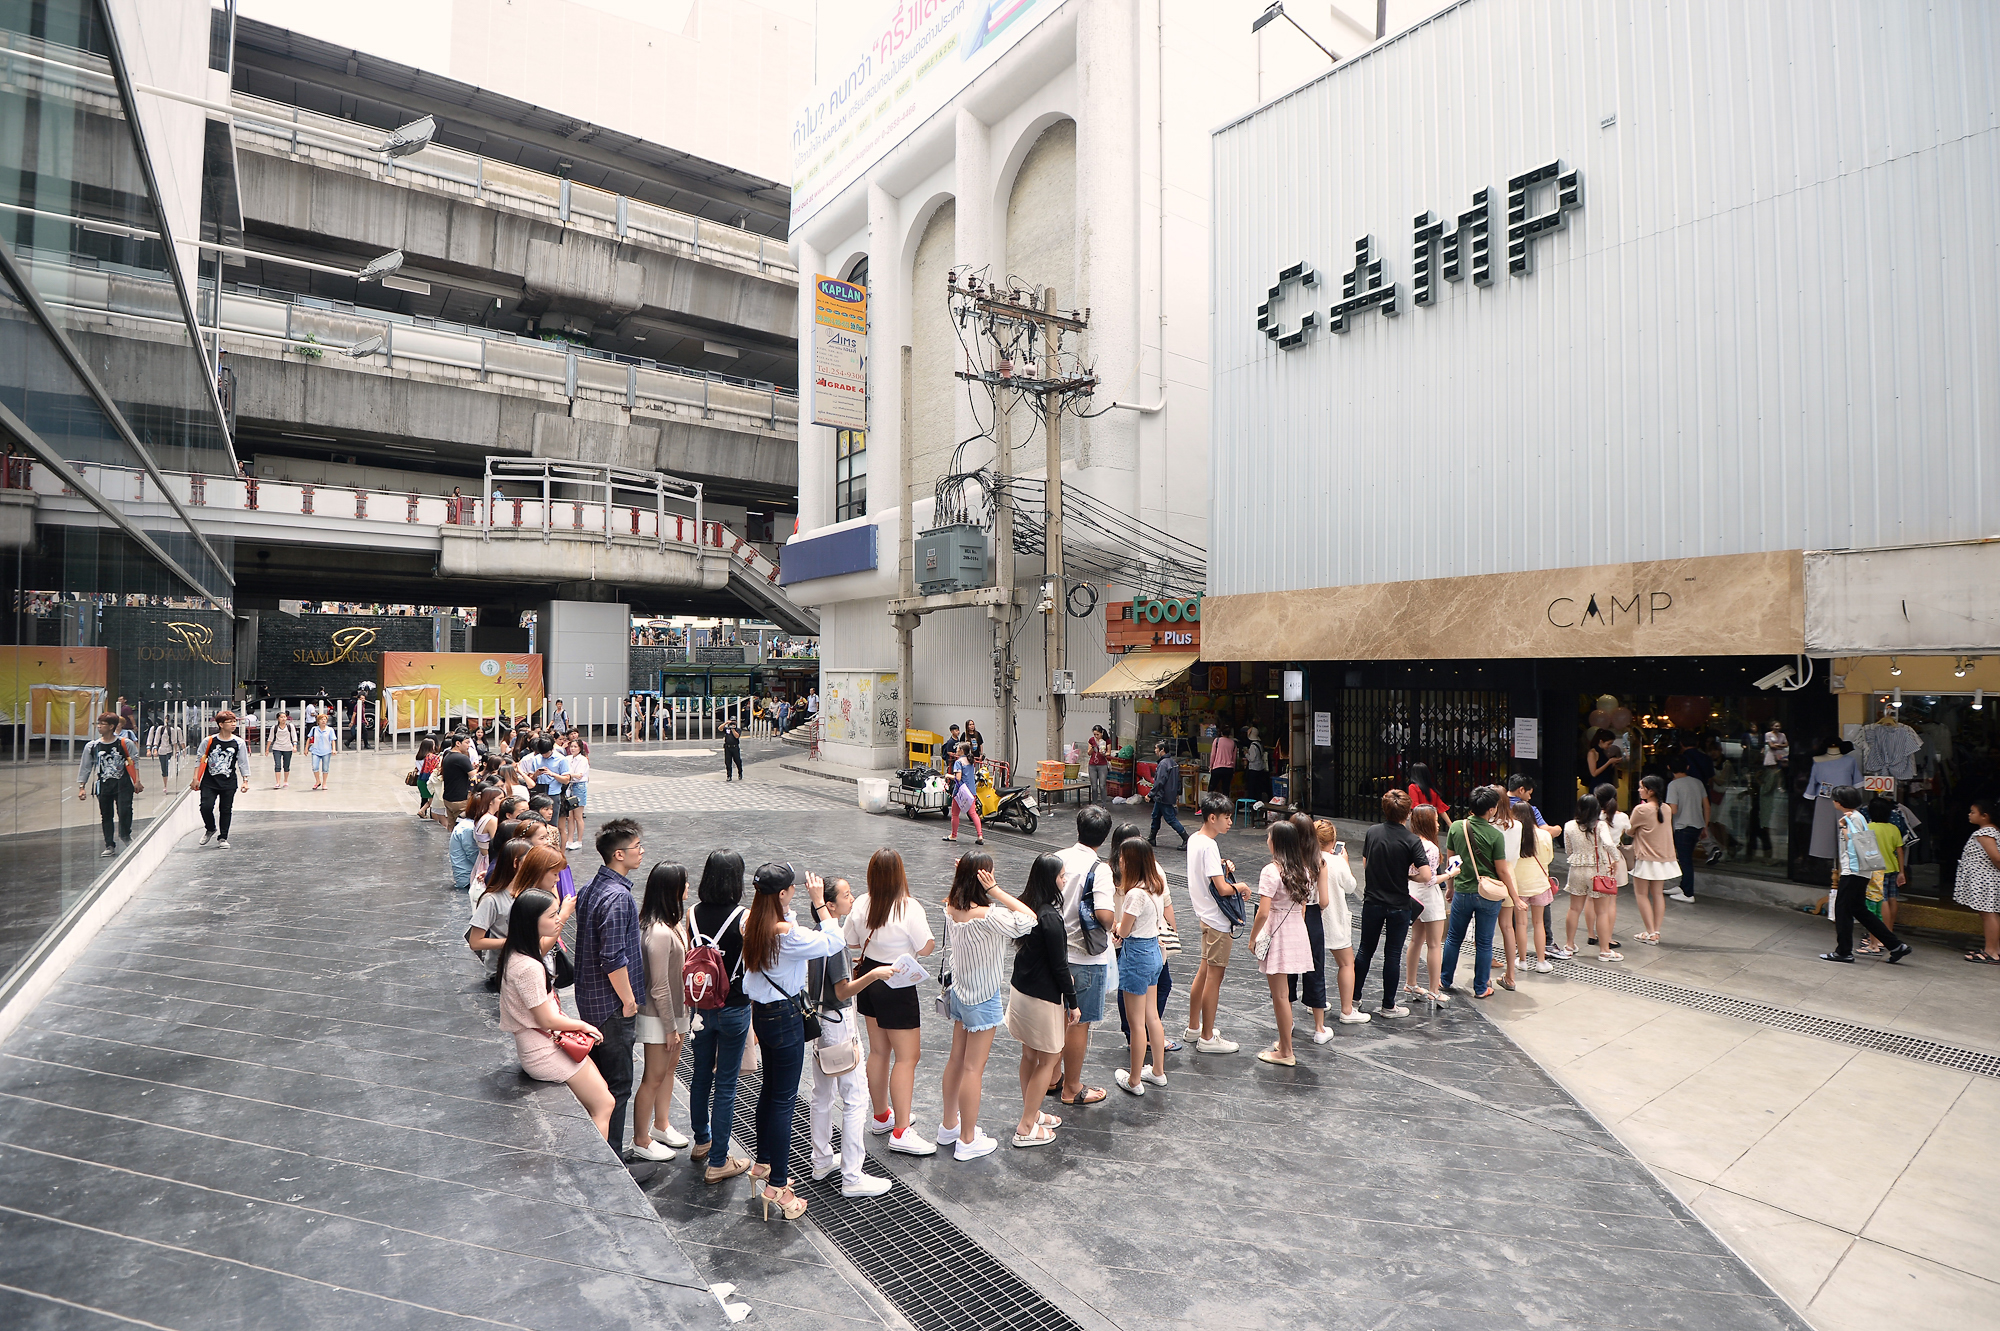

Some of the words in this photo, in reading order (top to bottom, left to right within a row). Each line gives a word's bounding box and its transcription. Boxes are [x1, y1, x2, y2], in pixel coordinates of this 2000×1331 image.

[860, 118, 868, 131] SAT
[878, 101, 887, 114] ACT
[896, 80, 909, 97] TOEIC
[948, 37, 957, 49] CK
[823, 114, 847, 144] KAPLAN
[1256, 158, 1583, 350] CAMP
[821, 282, 861, 302] KAPLAN
[826, 333, 857, 348] AIMS
[827, 381, 857, 393] GRADE
[1133, 591, 1203, 624] Food
[1547, 593, 1672, 628] CAMP
[1164, 631, 1192, 645] Plus
[293, 649, 329, 663] SIAM
[1865, 777, 1893, 791] 200
